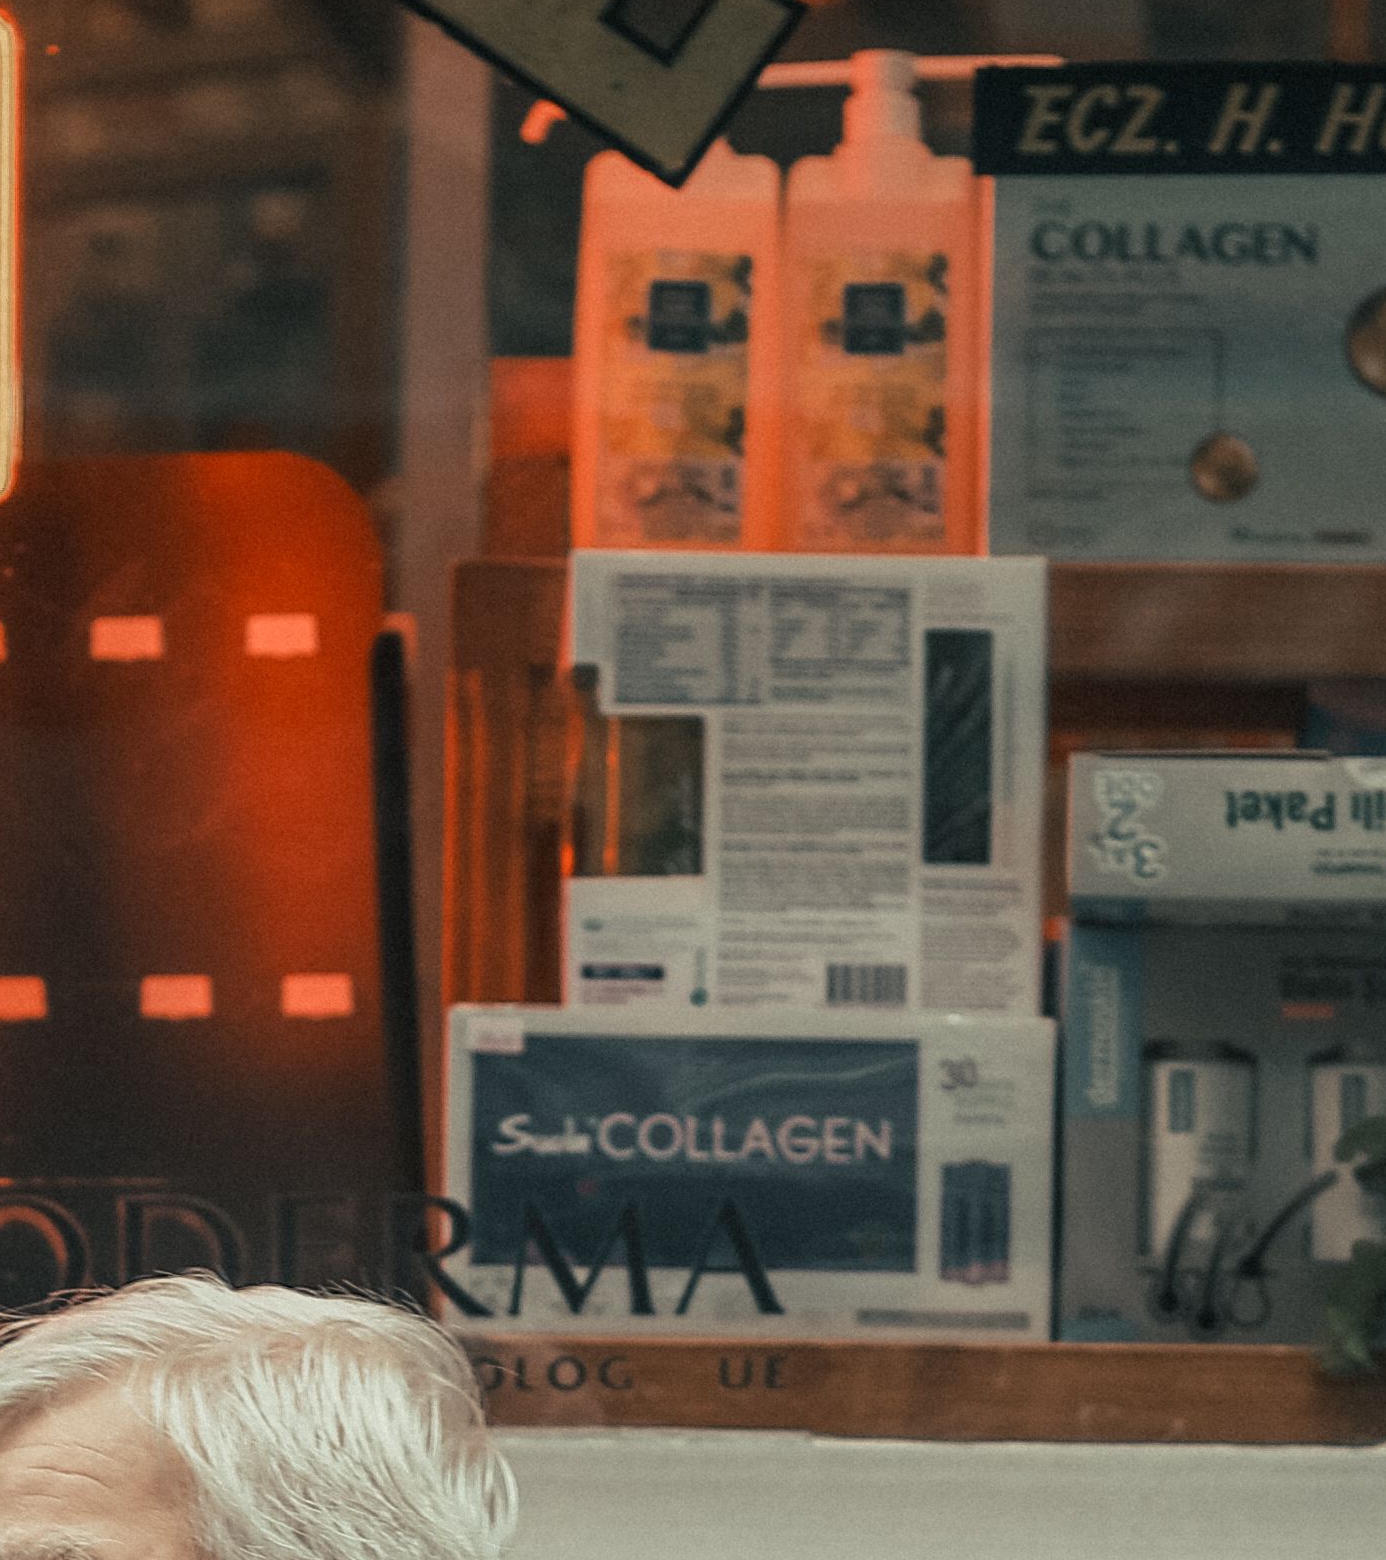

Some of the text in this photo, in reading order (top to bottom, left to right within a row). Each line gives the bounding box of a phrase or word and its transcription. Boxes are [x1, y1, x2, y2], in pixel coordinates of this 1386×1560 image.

[1017, 80, 1180, 156] ECZ.
[1208, 80, 1284, 156] H.
[1029, 220, 1318, 264] COLLAGEN
[1224, 790, 1335, 831] Paket
